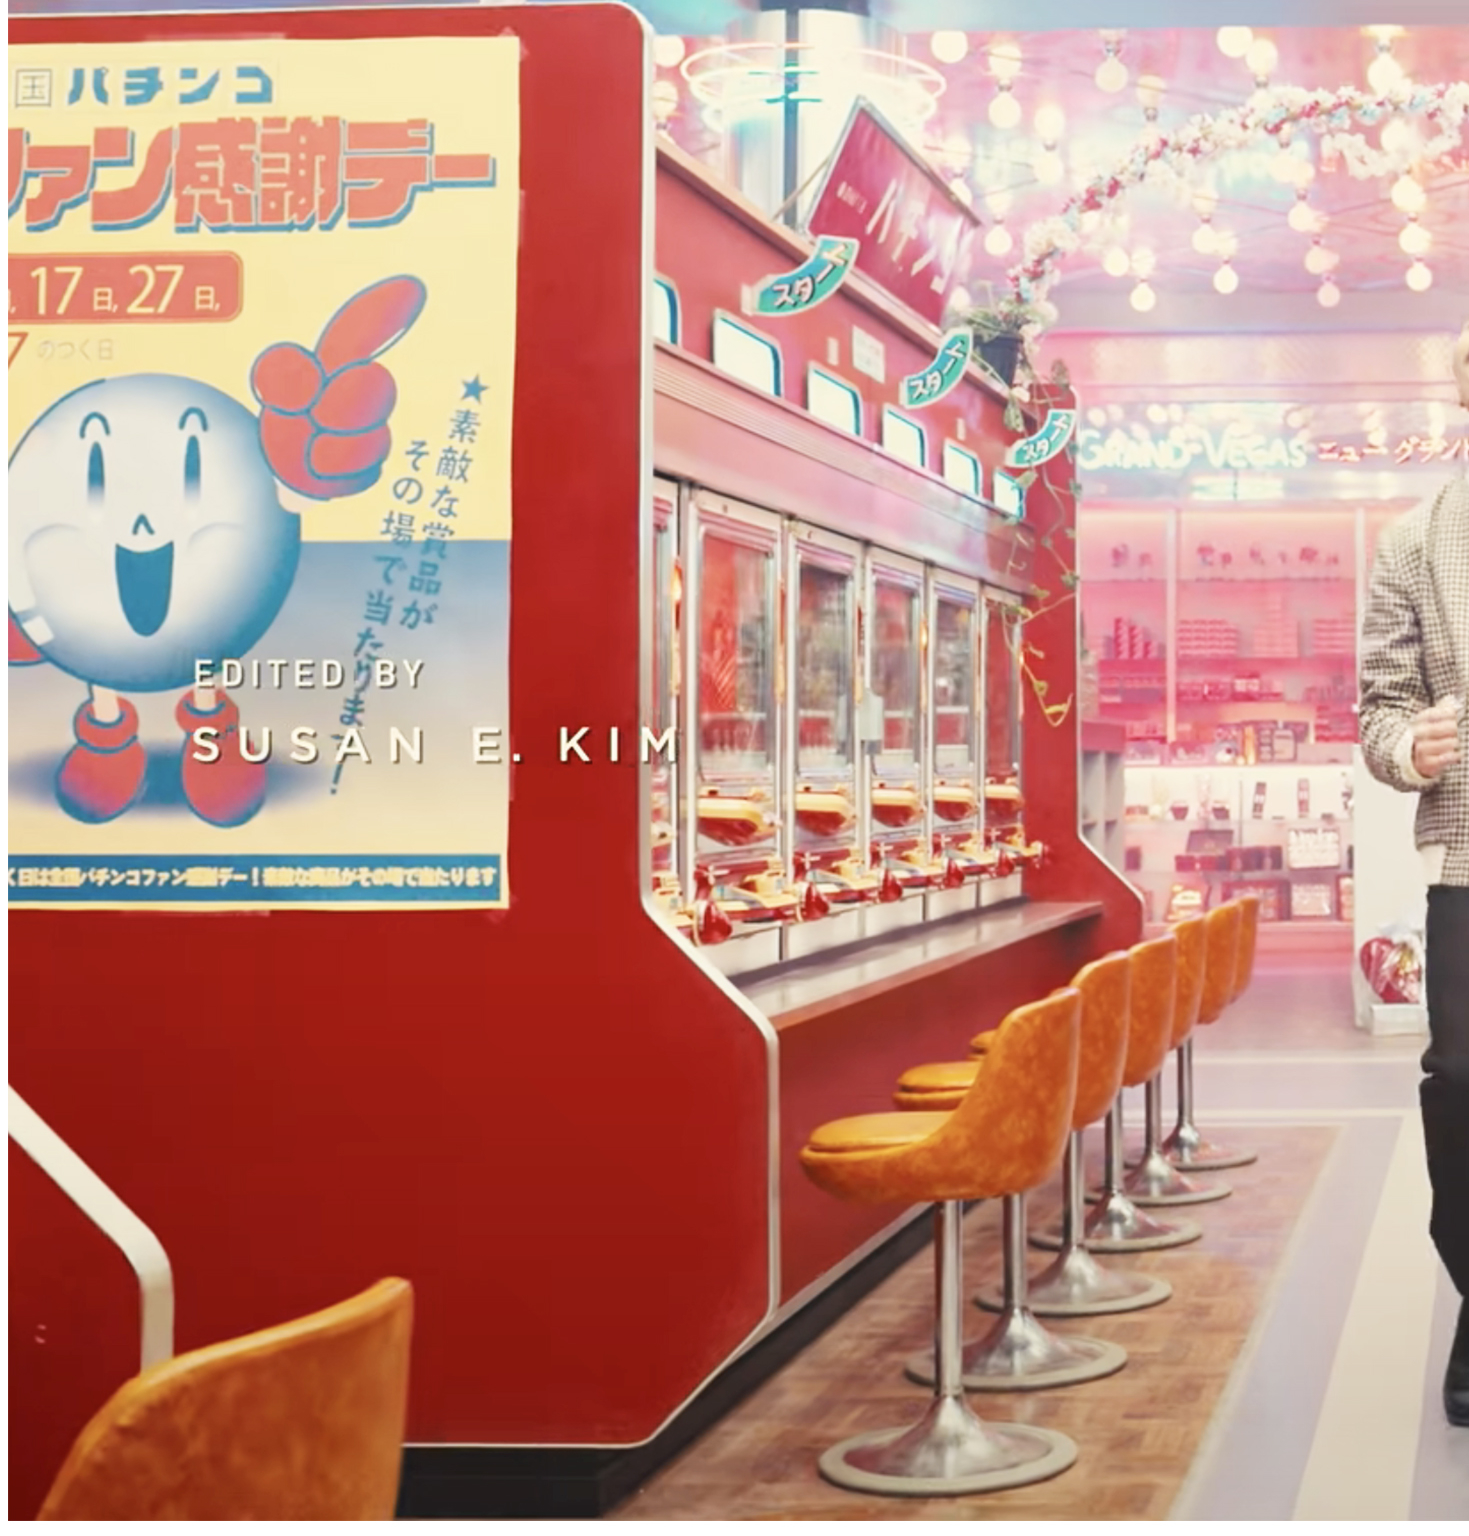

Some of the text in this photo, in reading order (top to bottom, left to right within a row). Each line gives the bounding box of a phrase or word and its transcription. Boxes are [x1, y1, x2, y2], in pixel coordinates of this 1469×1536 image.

[8, 115, 496, 233] ァン感謝デー
[773, 241, 848, 306] スタート
[908, 340, 966, 398] スタート
[1022, 413, 1071, 460] スタート
[399, 408, 481, 630] 素敵な賞品が
